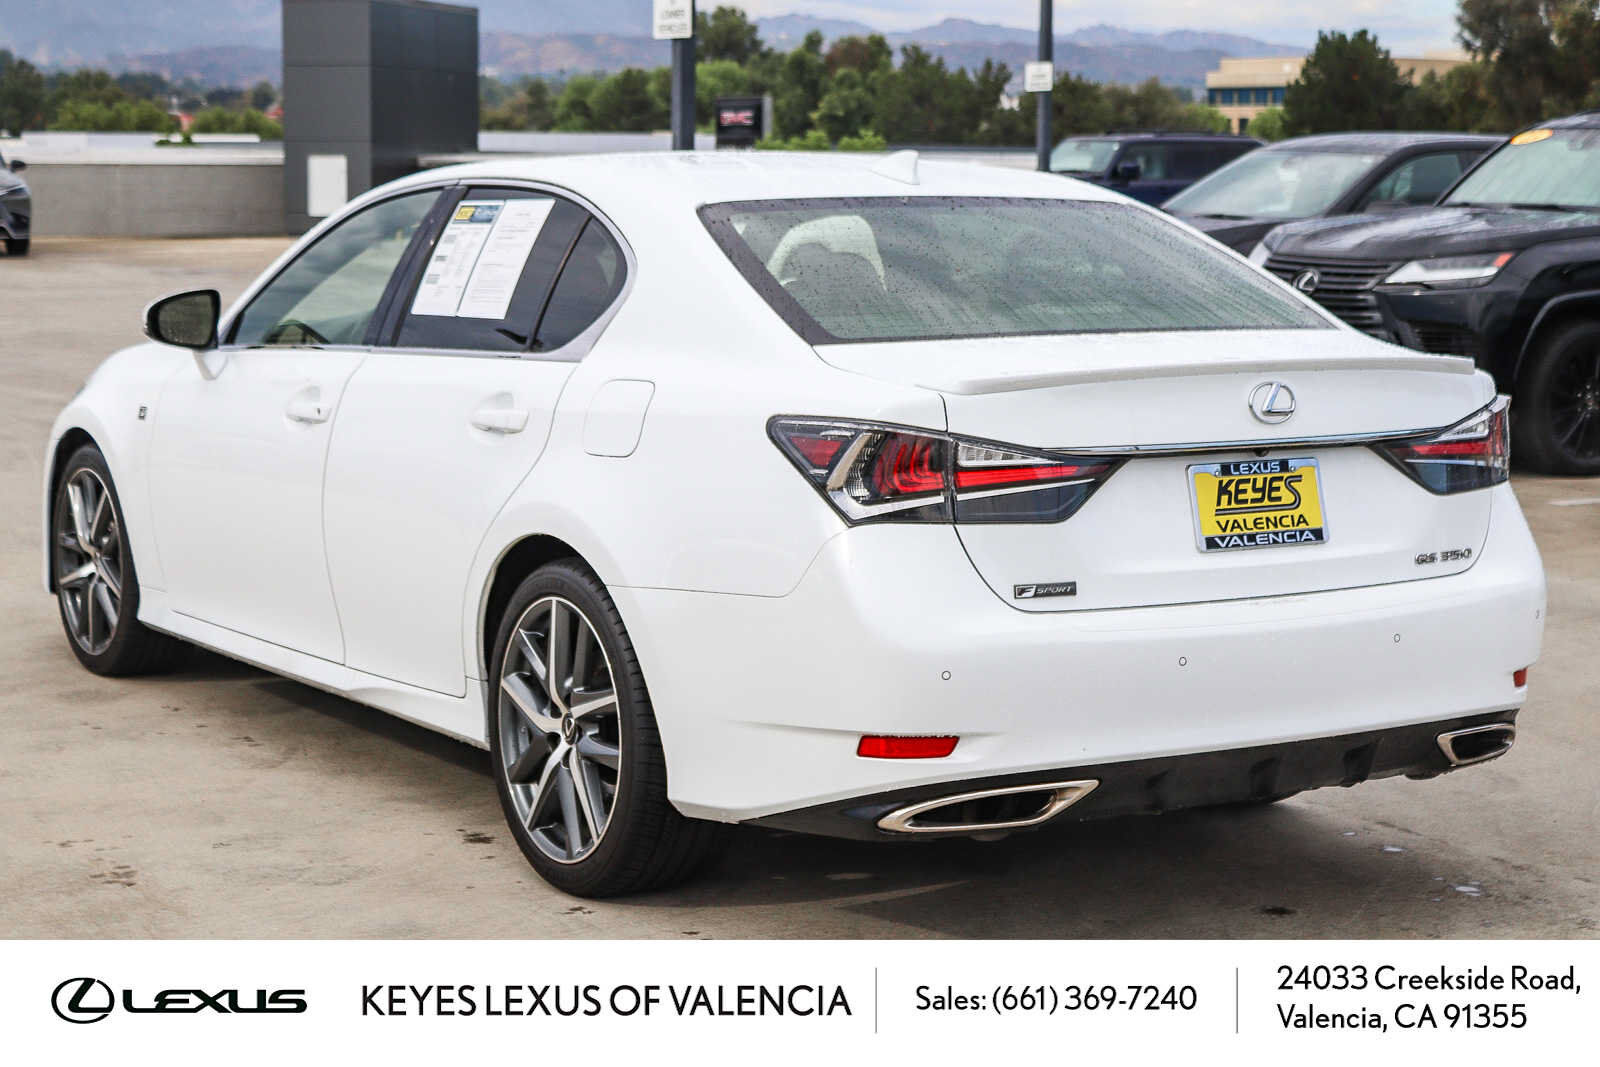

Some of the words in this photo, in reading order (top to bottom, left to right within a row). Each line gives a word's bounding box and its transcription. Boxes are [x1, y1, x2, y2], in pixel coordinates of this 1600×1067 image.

[1230, 462, 1281, 475] LEXUS
[1215, 475, 1302, 512] KEYES
[1216, 514, 1309, 533] VALENCIA
[1214, 531, 1316, 548] VALENCIA
[1439, 548, 1472, 561] 350
[1036, 585, 1072, 594] SPORT
